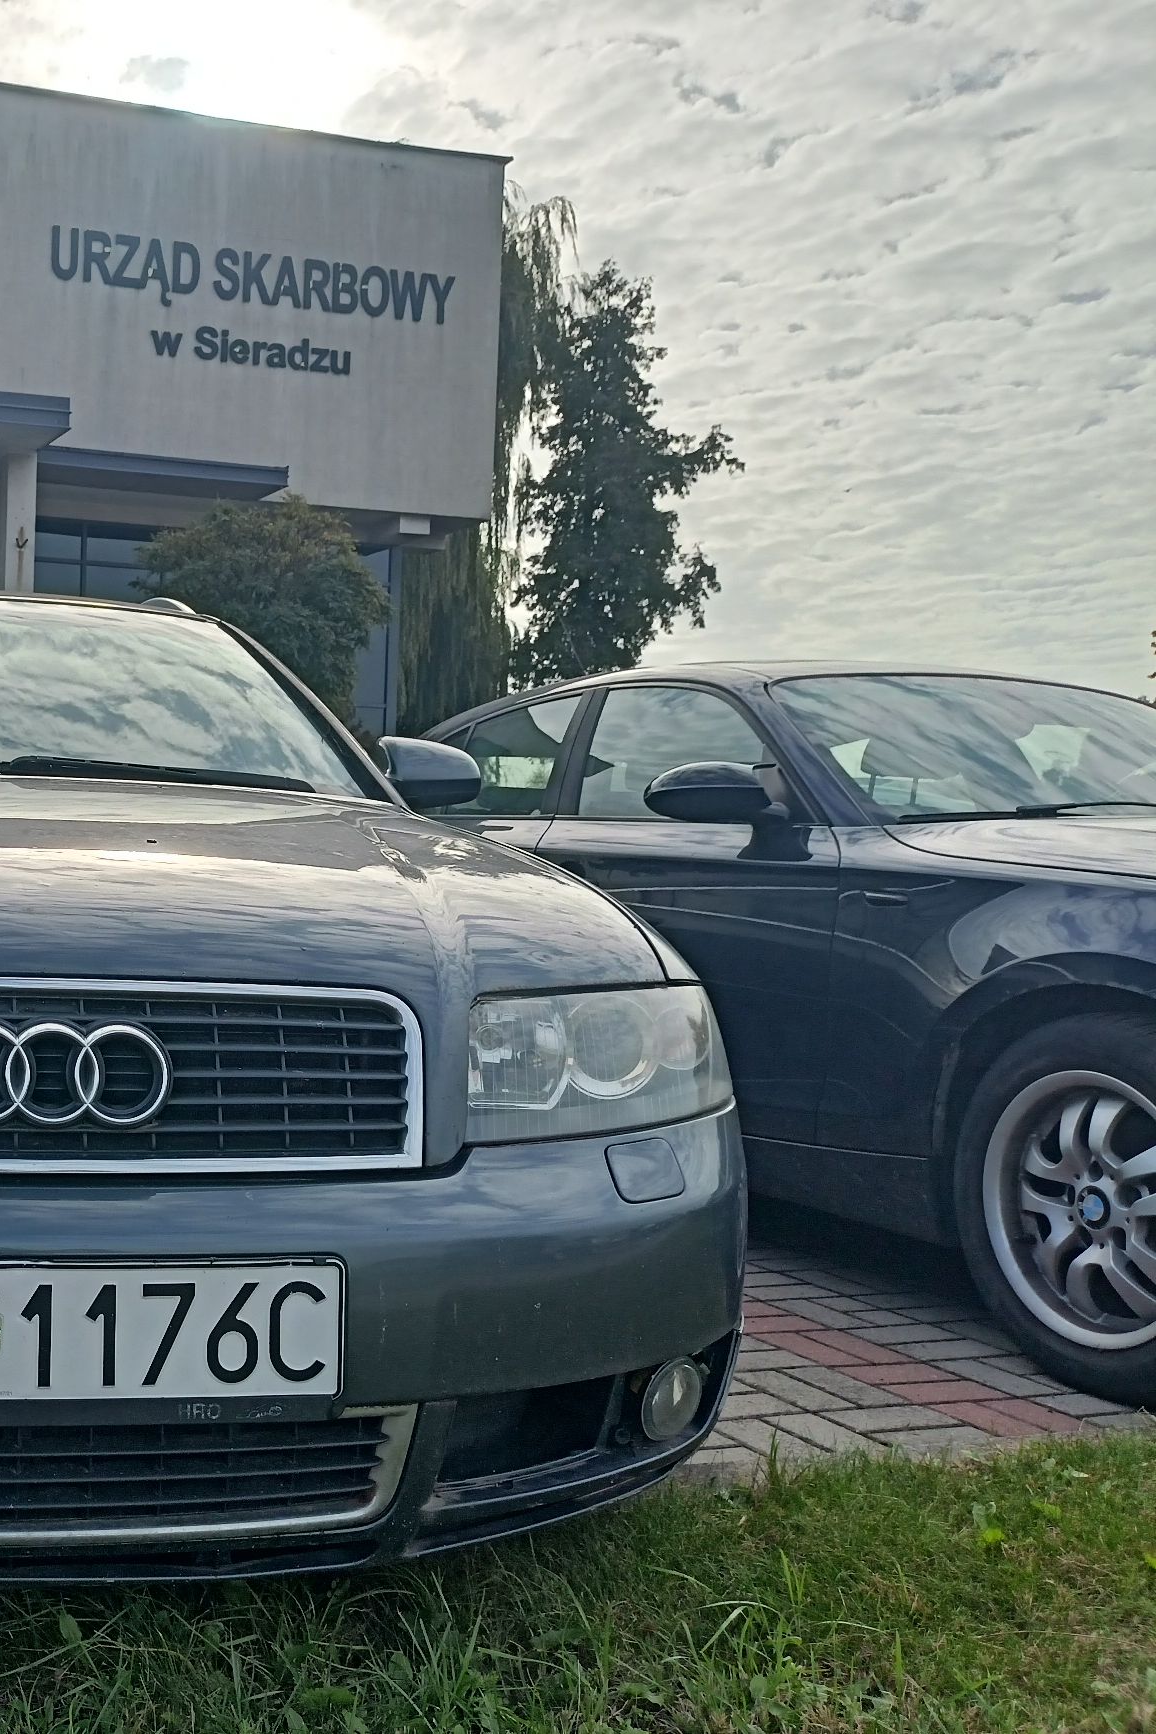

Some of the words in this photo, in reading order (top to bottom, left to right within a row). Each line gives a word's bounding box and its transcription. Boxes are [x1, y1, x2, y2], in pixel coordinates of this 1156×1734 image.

[51, 225, 201, 307] URZĄD
[212, 247, 456, 325] SKARBOWY
[151, 330, 183, 358] w
[194, 326, 352, 376] Sieradzu
[21, 1280, 328, 1388] 1176C
